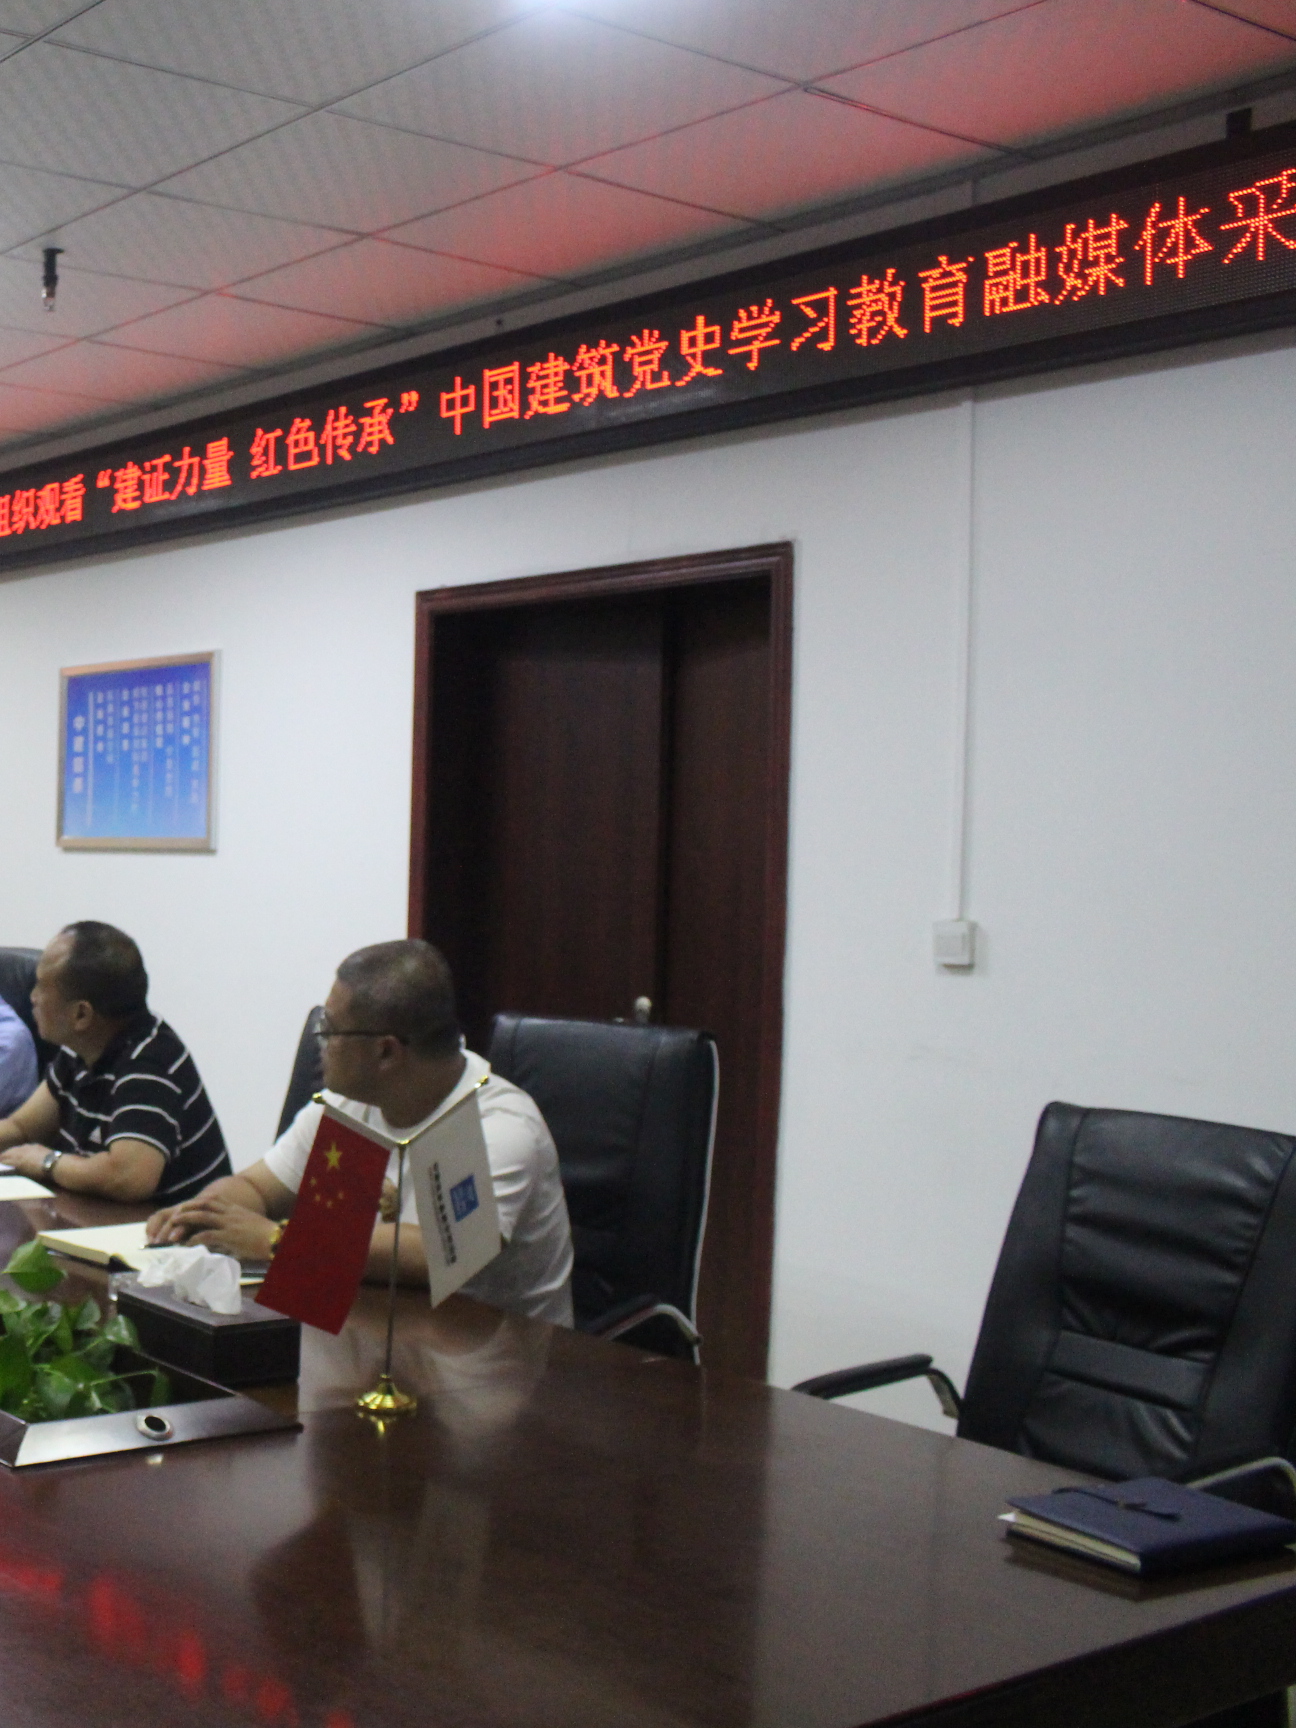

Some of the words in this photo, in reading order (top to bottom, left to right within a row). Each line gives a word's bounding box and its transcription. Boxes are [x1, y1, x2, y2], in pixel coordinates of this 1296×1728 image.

[95, 436, 235, 514] “建证力量
[249, 390, 420, 480] 红色传承”
